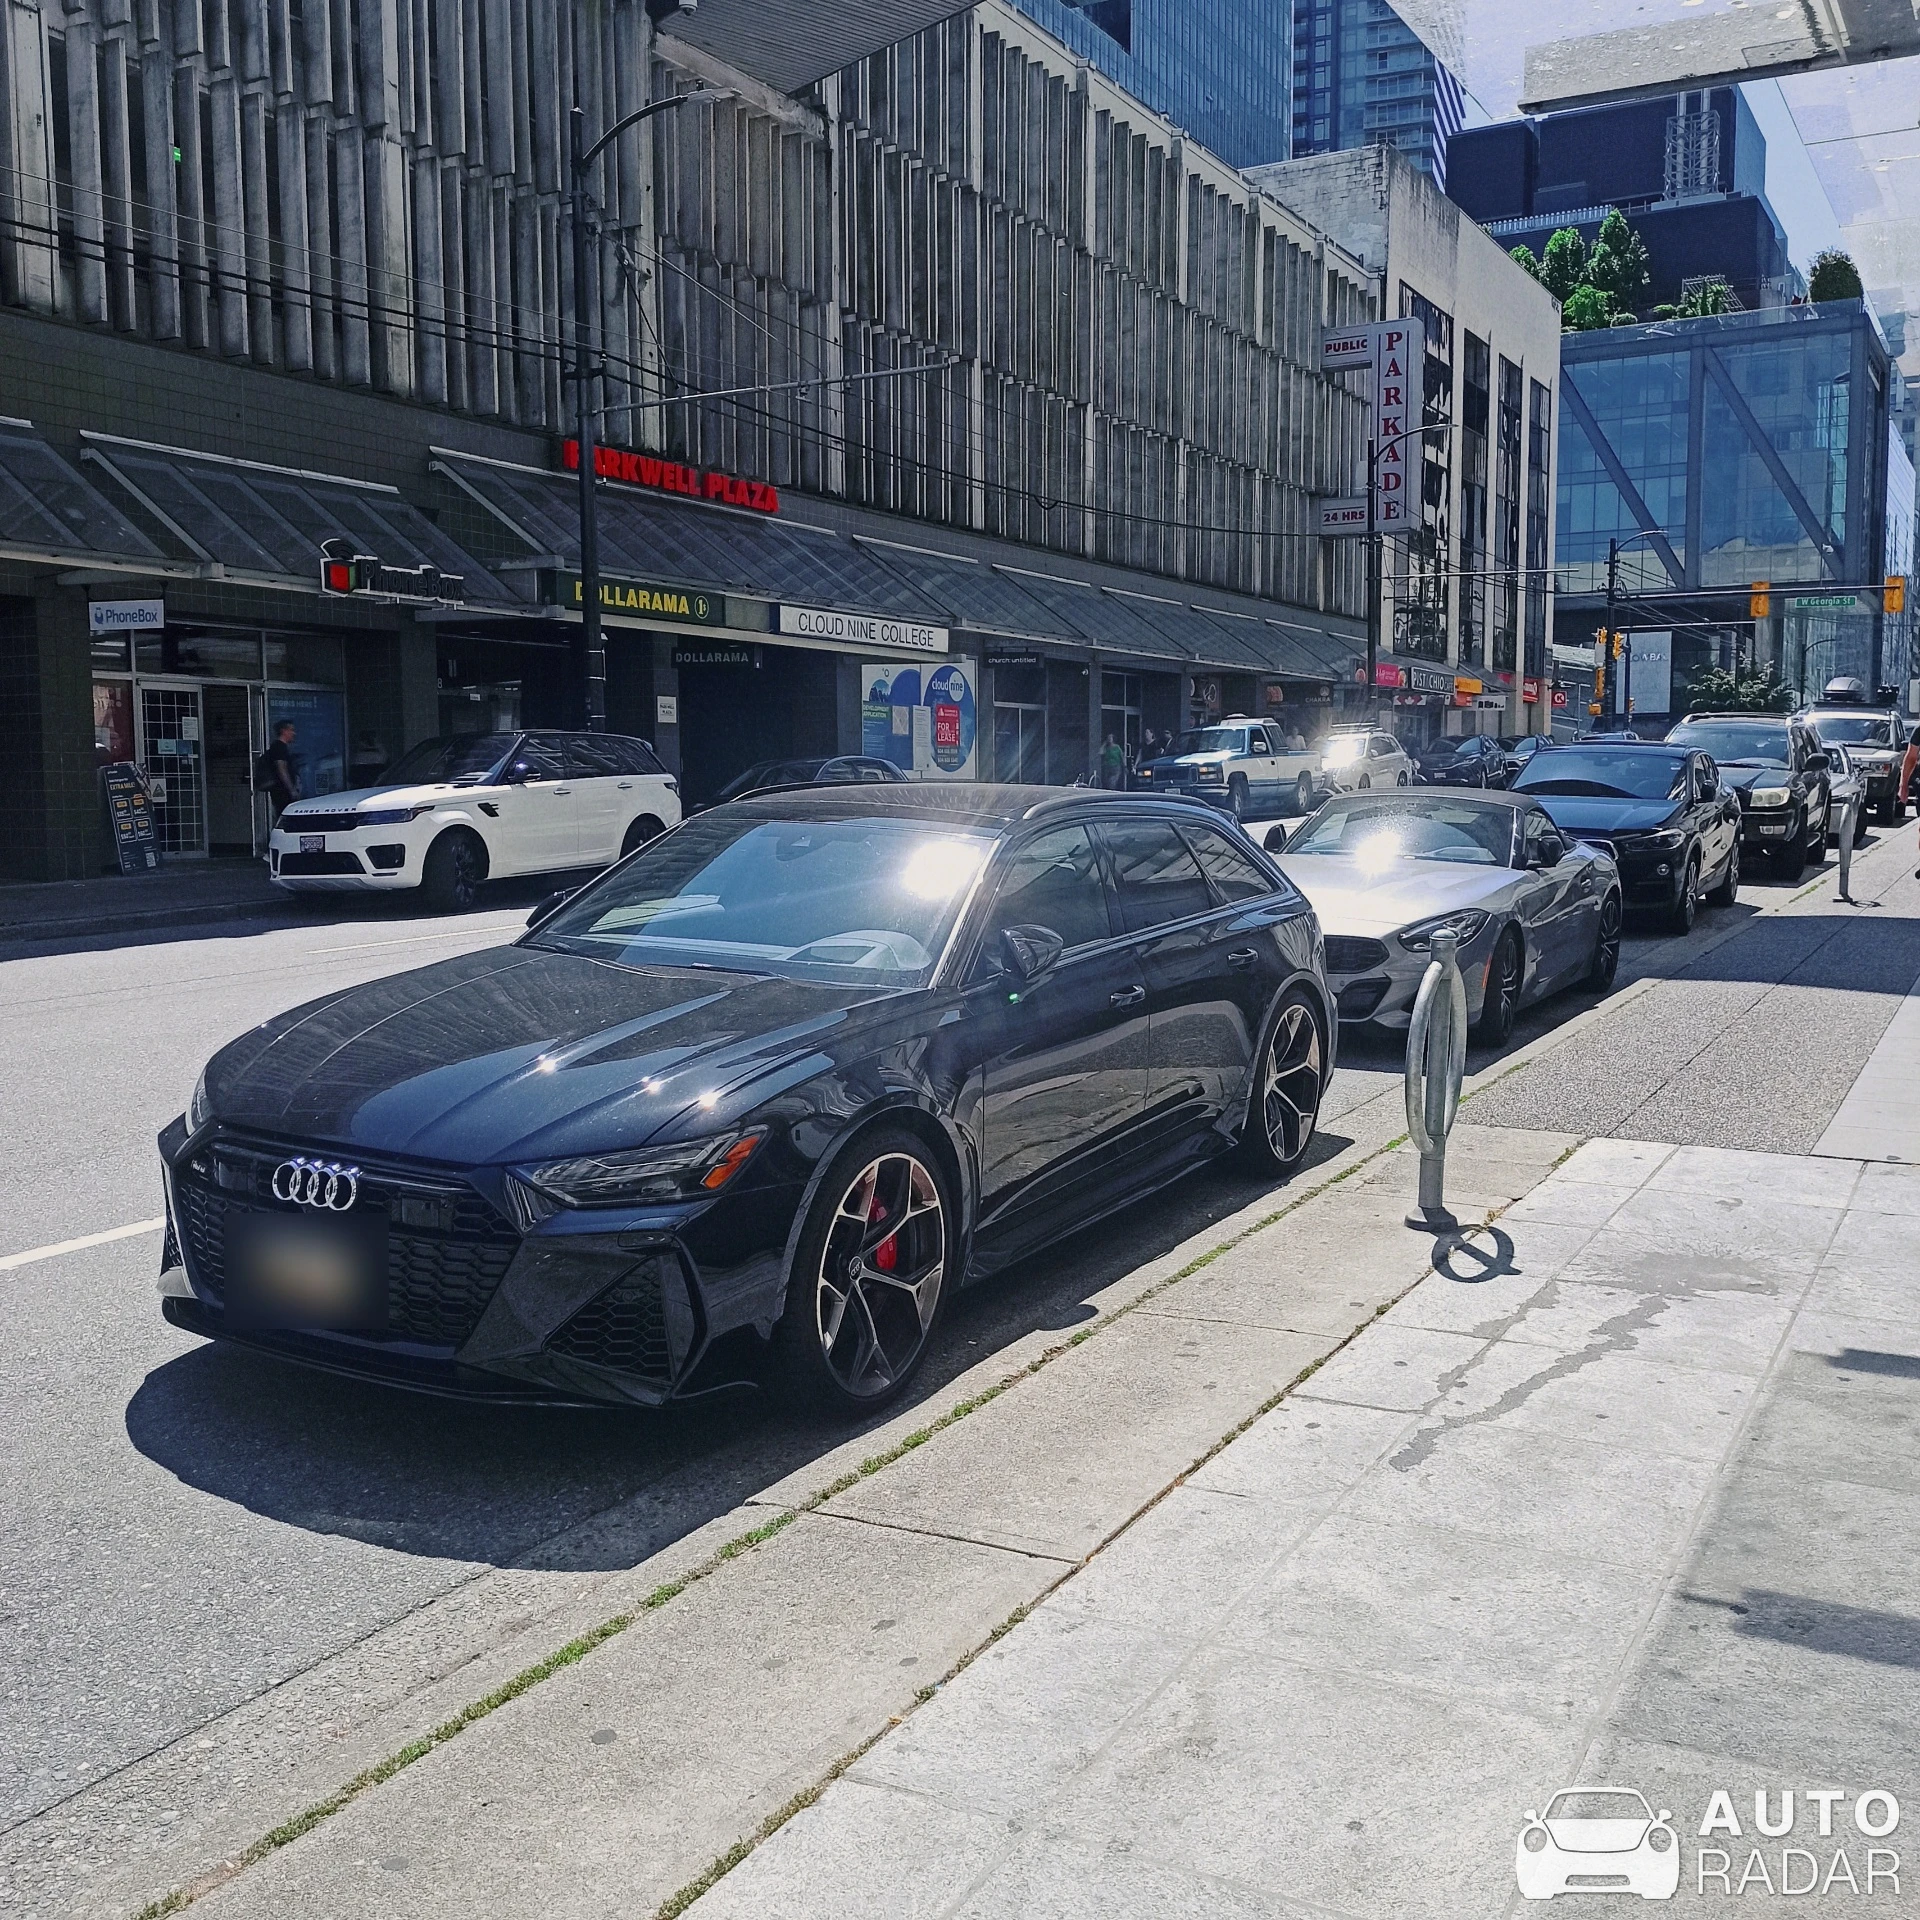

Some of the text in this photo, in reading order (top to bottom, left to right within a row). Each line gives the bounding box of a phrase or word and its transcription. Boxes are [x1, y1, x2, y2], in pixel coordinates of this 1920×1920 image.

[1325, 338, 1368, 353] PUBLIC
[1381, 330, 1403, 521] PARKADE
[705, 472, 779, 513] PLAZA
[1323, 510, 1365, 523] 24 HRS
[359, 558, 462, 600] PhoneBox
[575, 580, 690, 615] DLLARAMA
[1810, 597, 1840, 607] Georgia
[1842, 597, 1851, 605] St
[105, 608, 158, 624] PhoneBox
[798, 612, 934, 647] CLOUD NINE COLLEGE
[675, 652, 749, 663] DOLLARAMA
[1618, 652, 1669, 664] GOWBAL
[931, 677, 964, 692] cloud nine
[937, 722, 950, 731] FOR
[937, 733, 956, 742] LEASE
